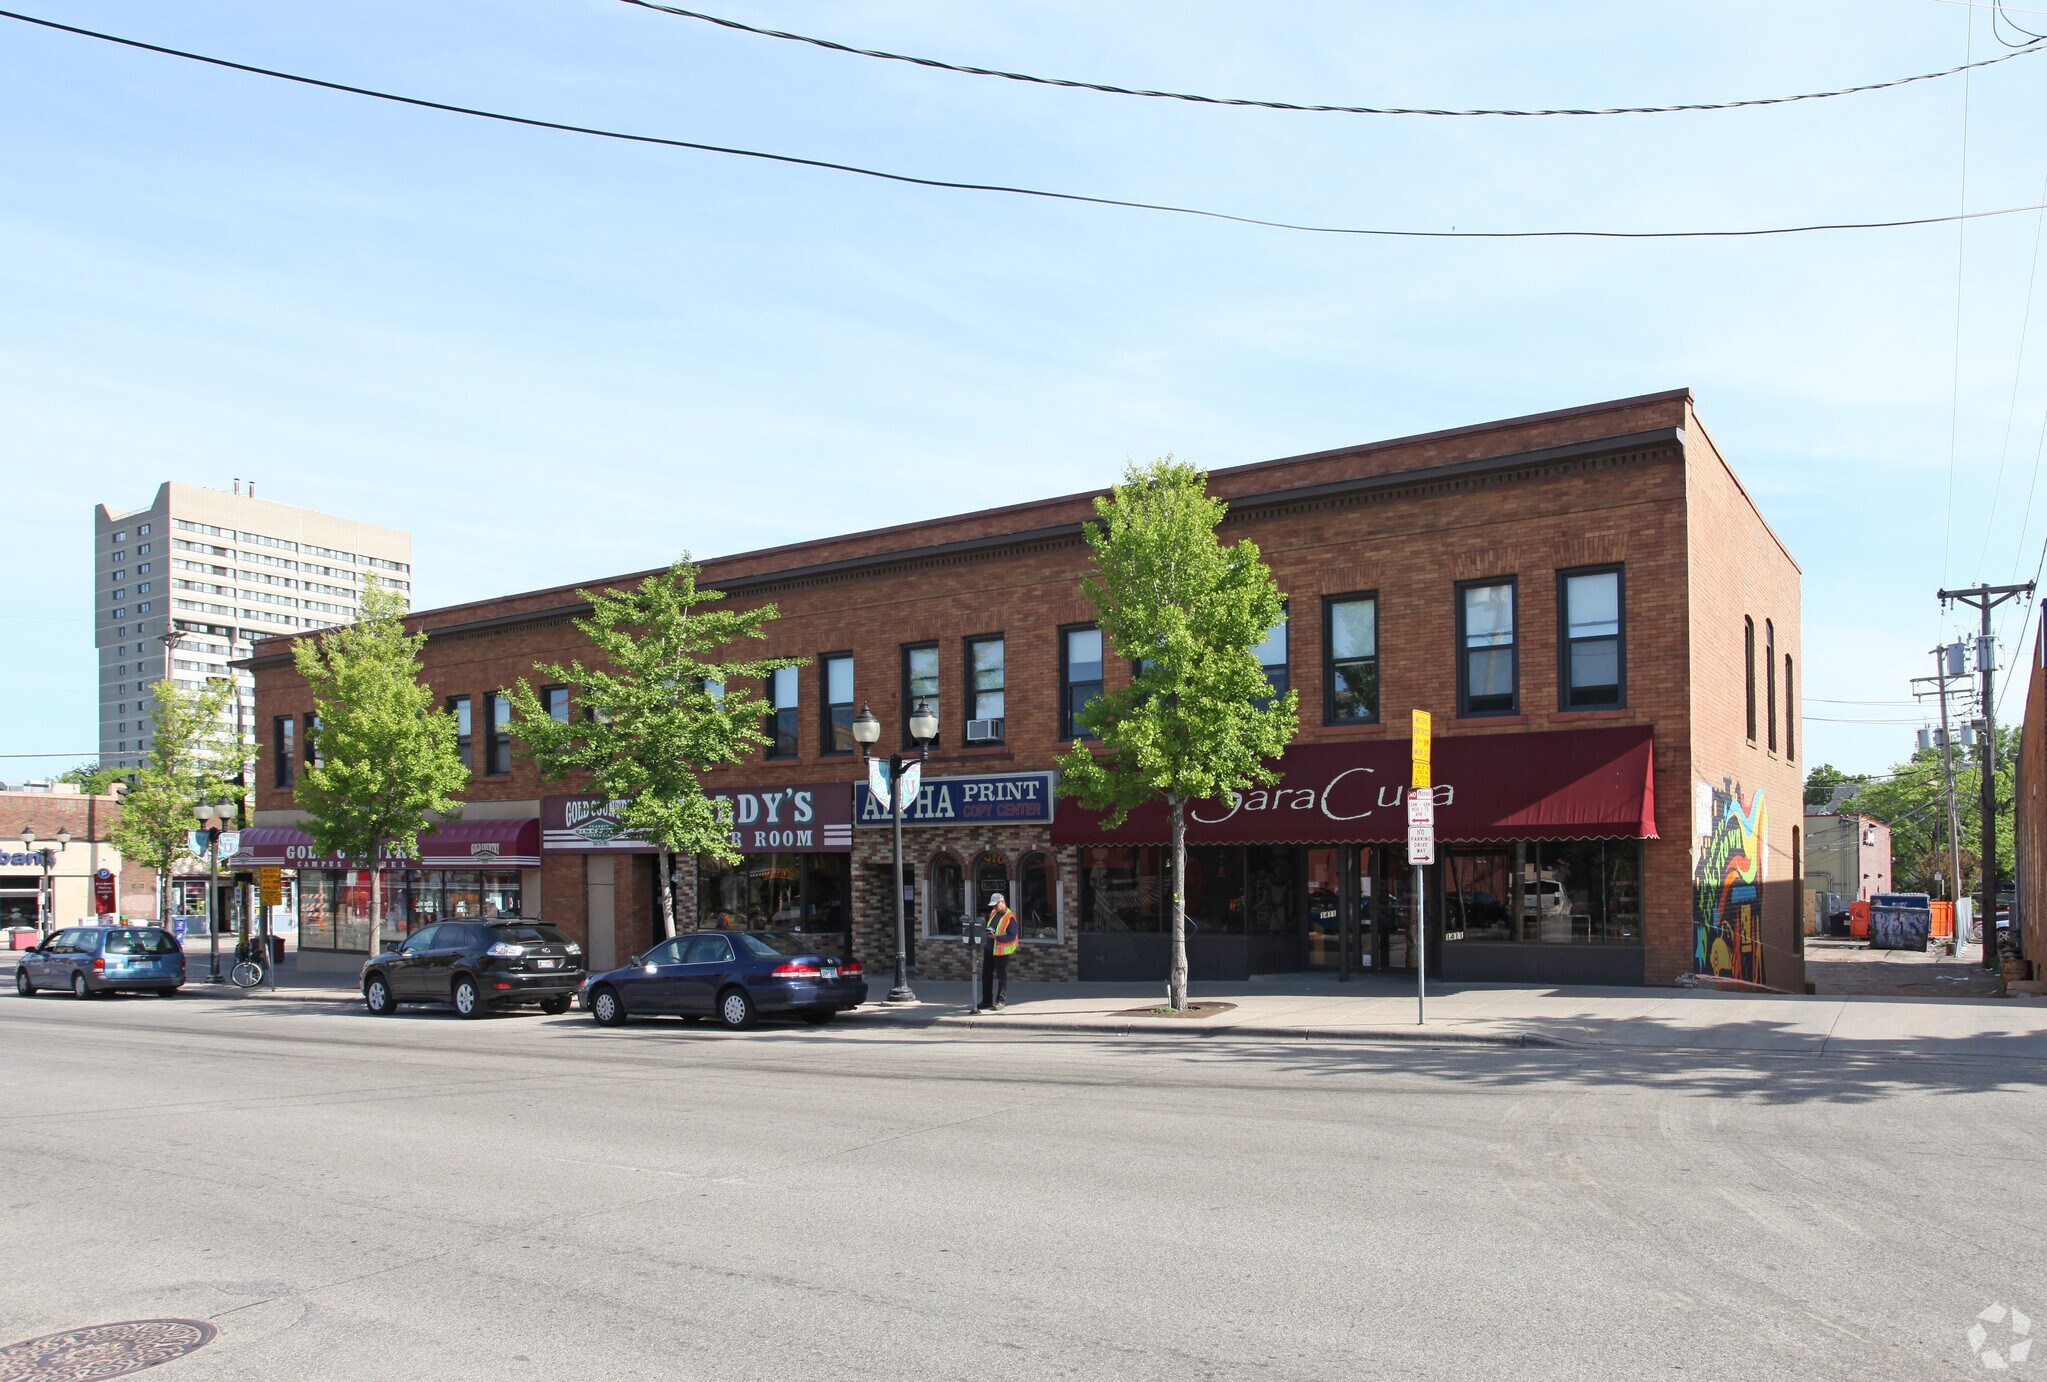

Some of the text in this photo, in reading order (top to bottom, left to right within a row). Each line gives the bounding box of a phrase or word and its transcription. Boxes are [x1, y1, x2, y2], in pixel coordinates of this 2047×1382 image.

[862, 781, 1040, 820] AHA PRINT
[963, 802, 1041, 818] COPY CENTER
[565, 800, 590, 828] GOLD
[754, 829, 814, 848] ROOM
[286, 845, 320, 859] GOL
